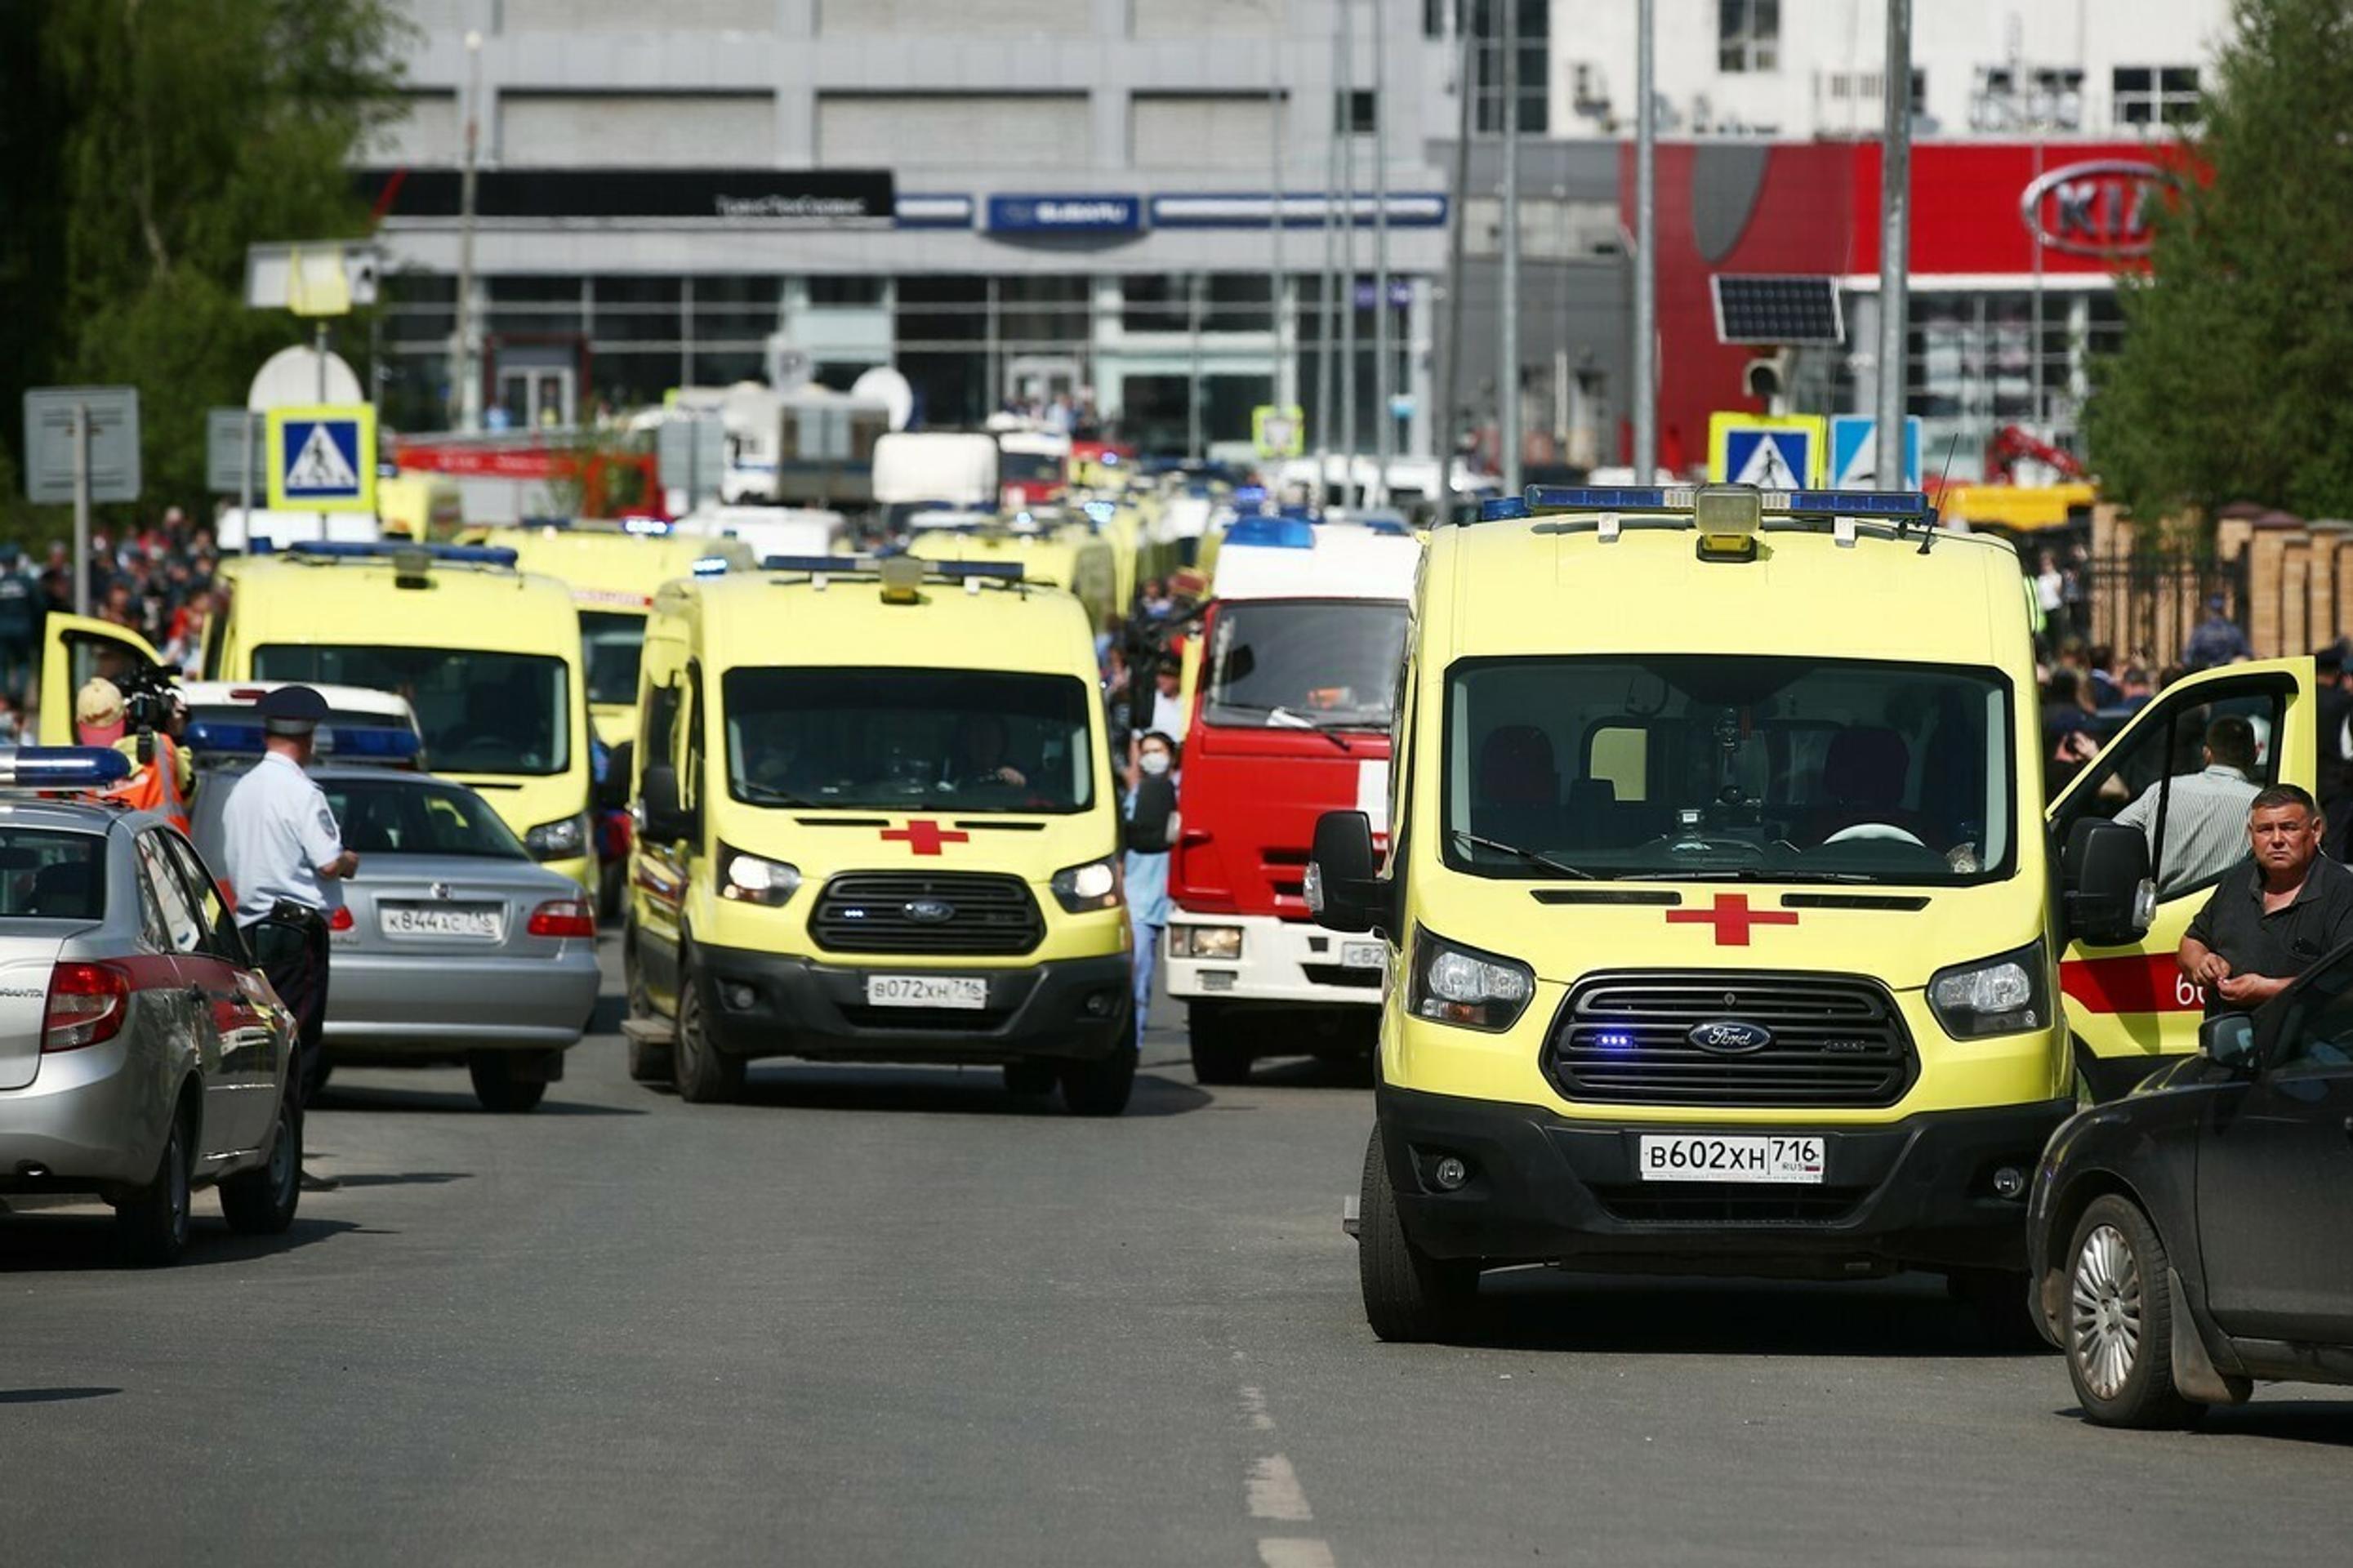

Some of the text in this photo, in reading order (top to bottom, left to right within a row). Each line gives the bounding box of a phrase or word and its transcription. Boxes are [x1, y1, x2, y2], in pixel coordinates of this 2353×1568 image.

[875, 980, 948, 999] В072ХН
[1708, 1026, 1752, 1046] Ford
[1650, 1140, 1816, 1169] В602ХН 716
[1782, 1162, 1804, 1171] RUS
